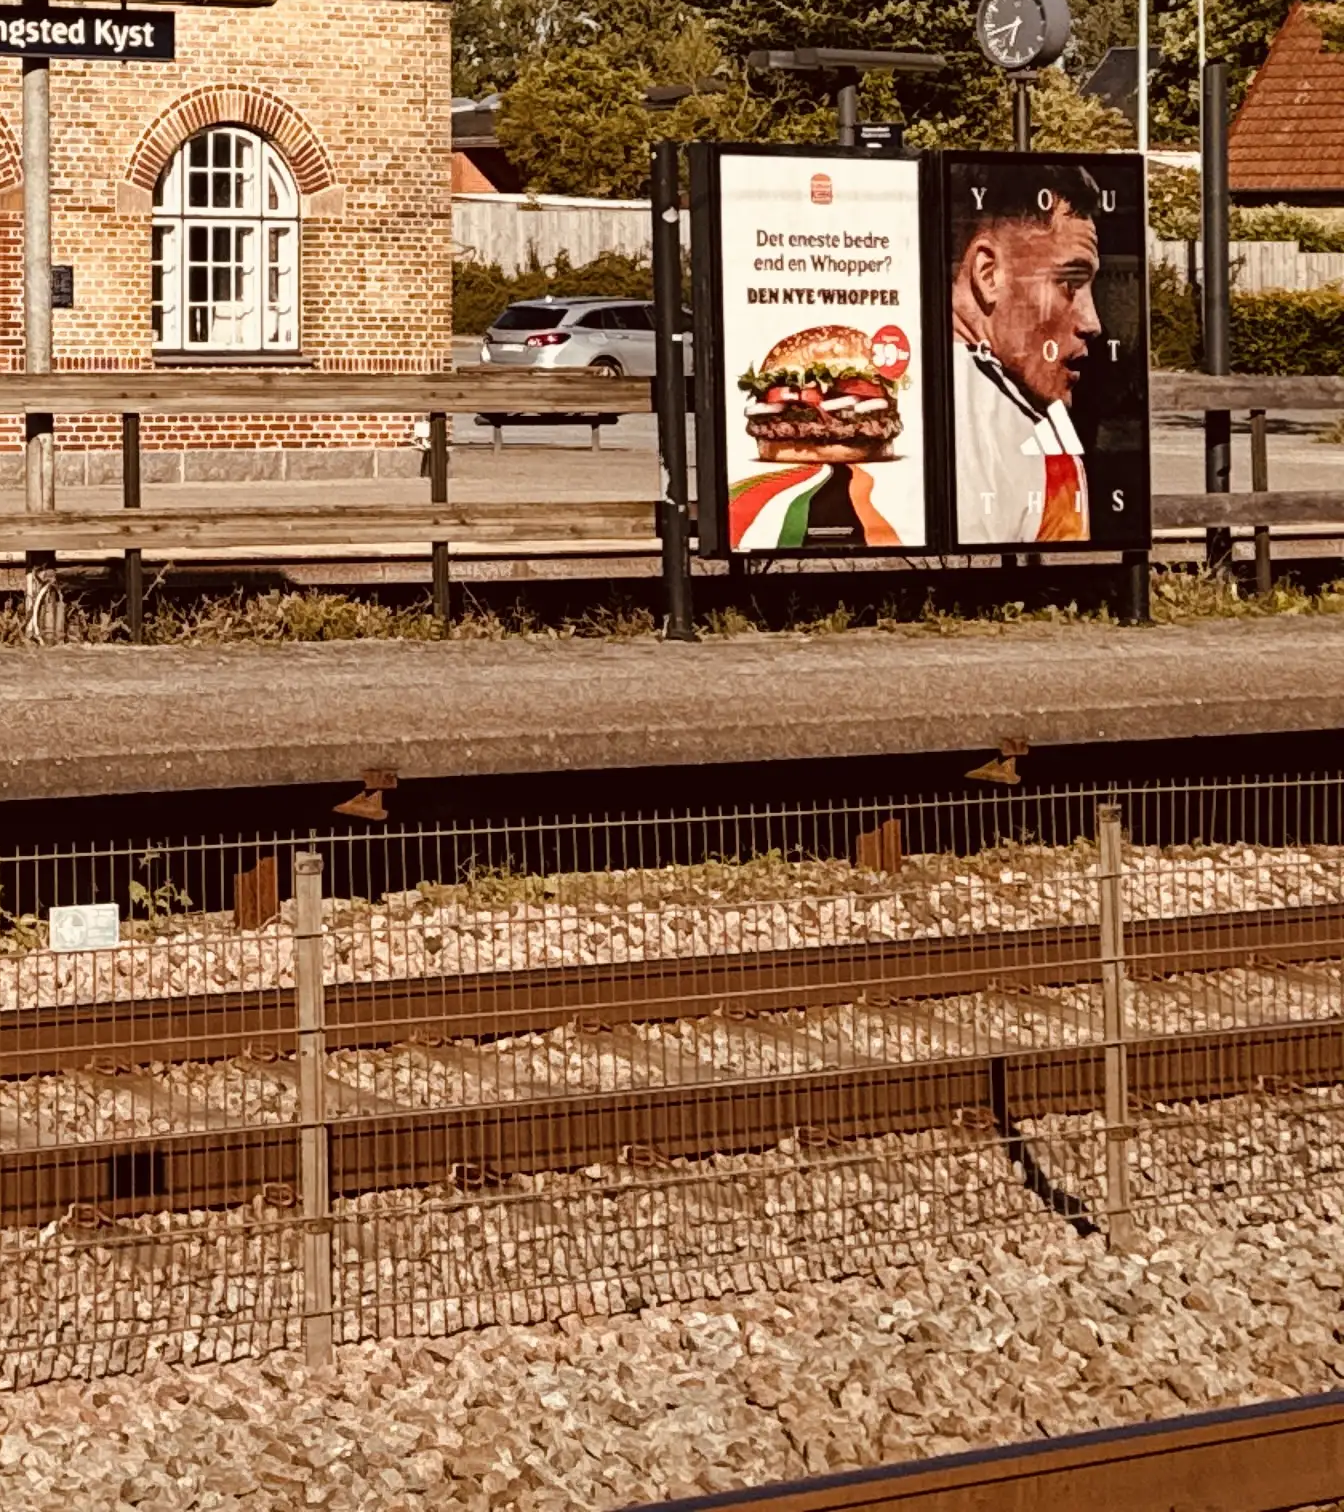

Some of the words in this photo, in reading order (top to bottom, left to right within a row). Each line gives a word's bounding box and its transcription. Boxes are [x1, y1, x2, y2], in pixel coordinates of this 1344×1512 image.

[94, 18, 155, 53] Kyst
[755, 229, 784, 248] Det
[788, 233, 840, 249] eneste
[843, 231, 890, 249] bedre
[753, 254, 784, 272] end
[787, 258, 807, 272] en
[810, 254, 893, 277] Whopper?
[746, 287, 779, 305] DEN
[782, 288, 815, 305] NYE
[817, 289, 900, 306] WHOPPER
